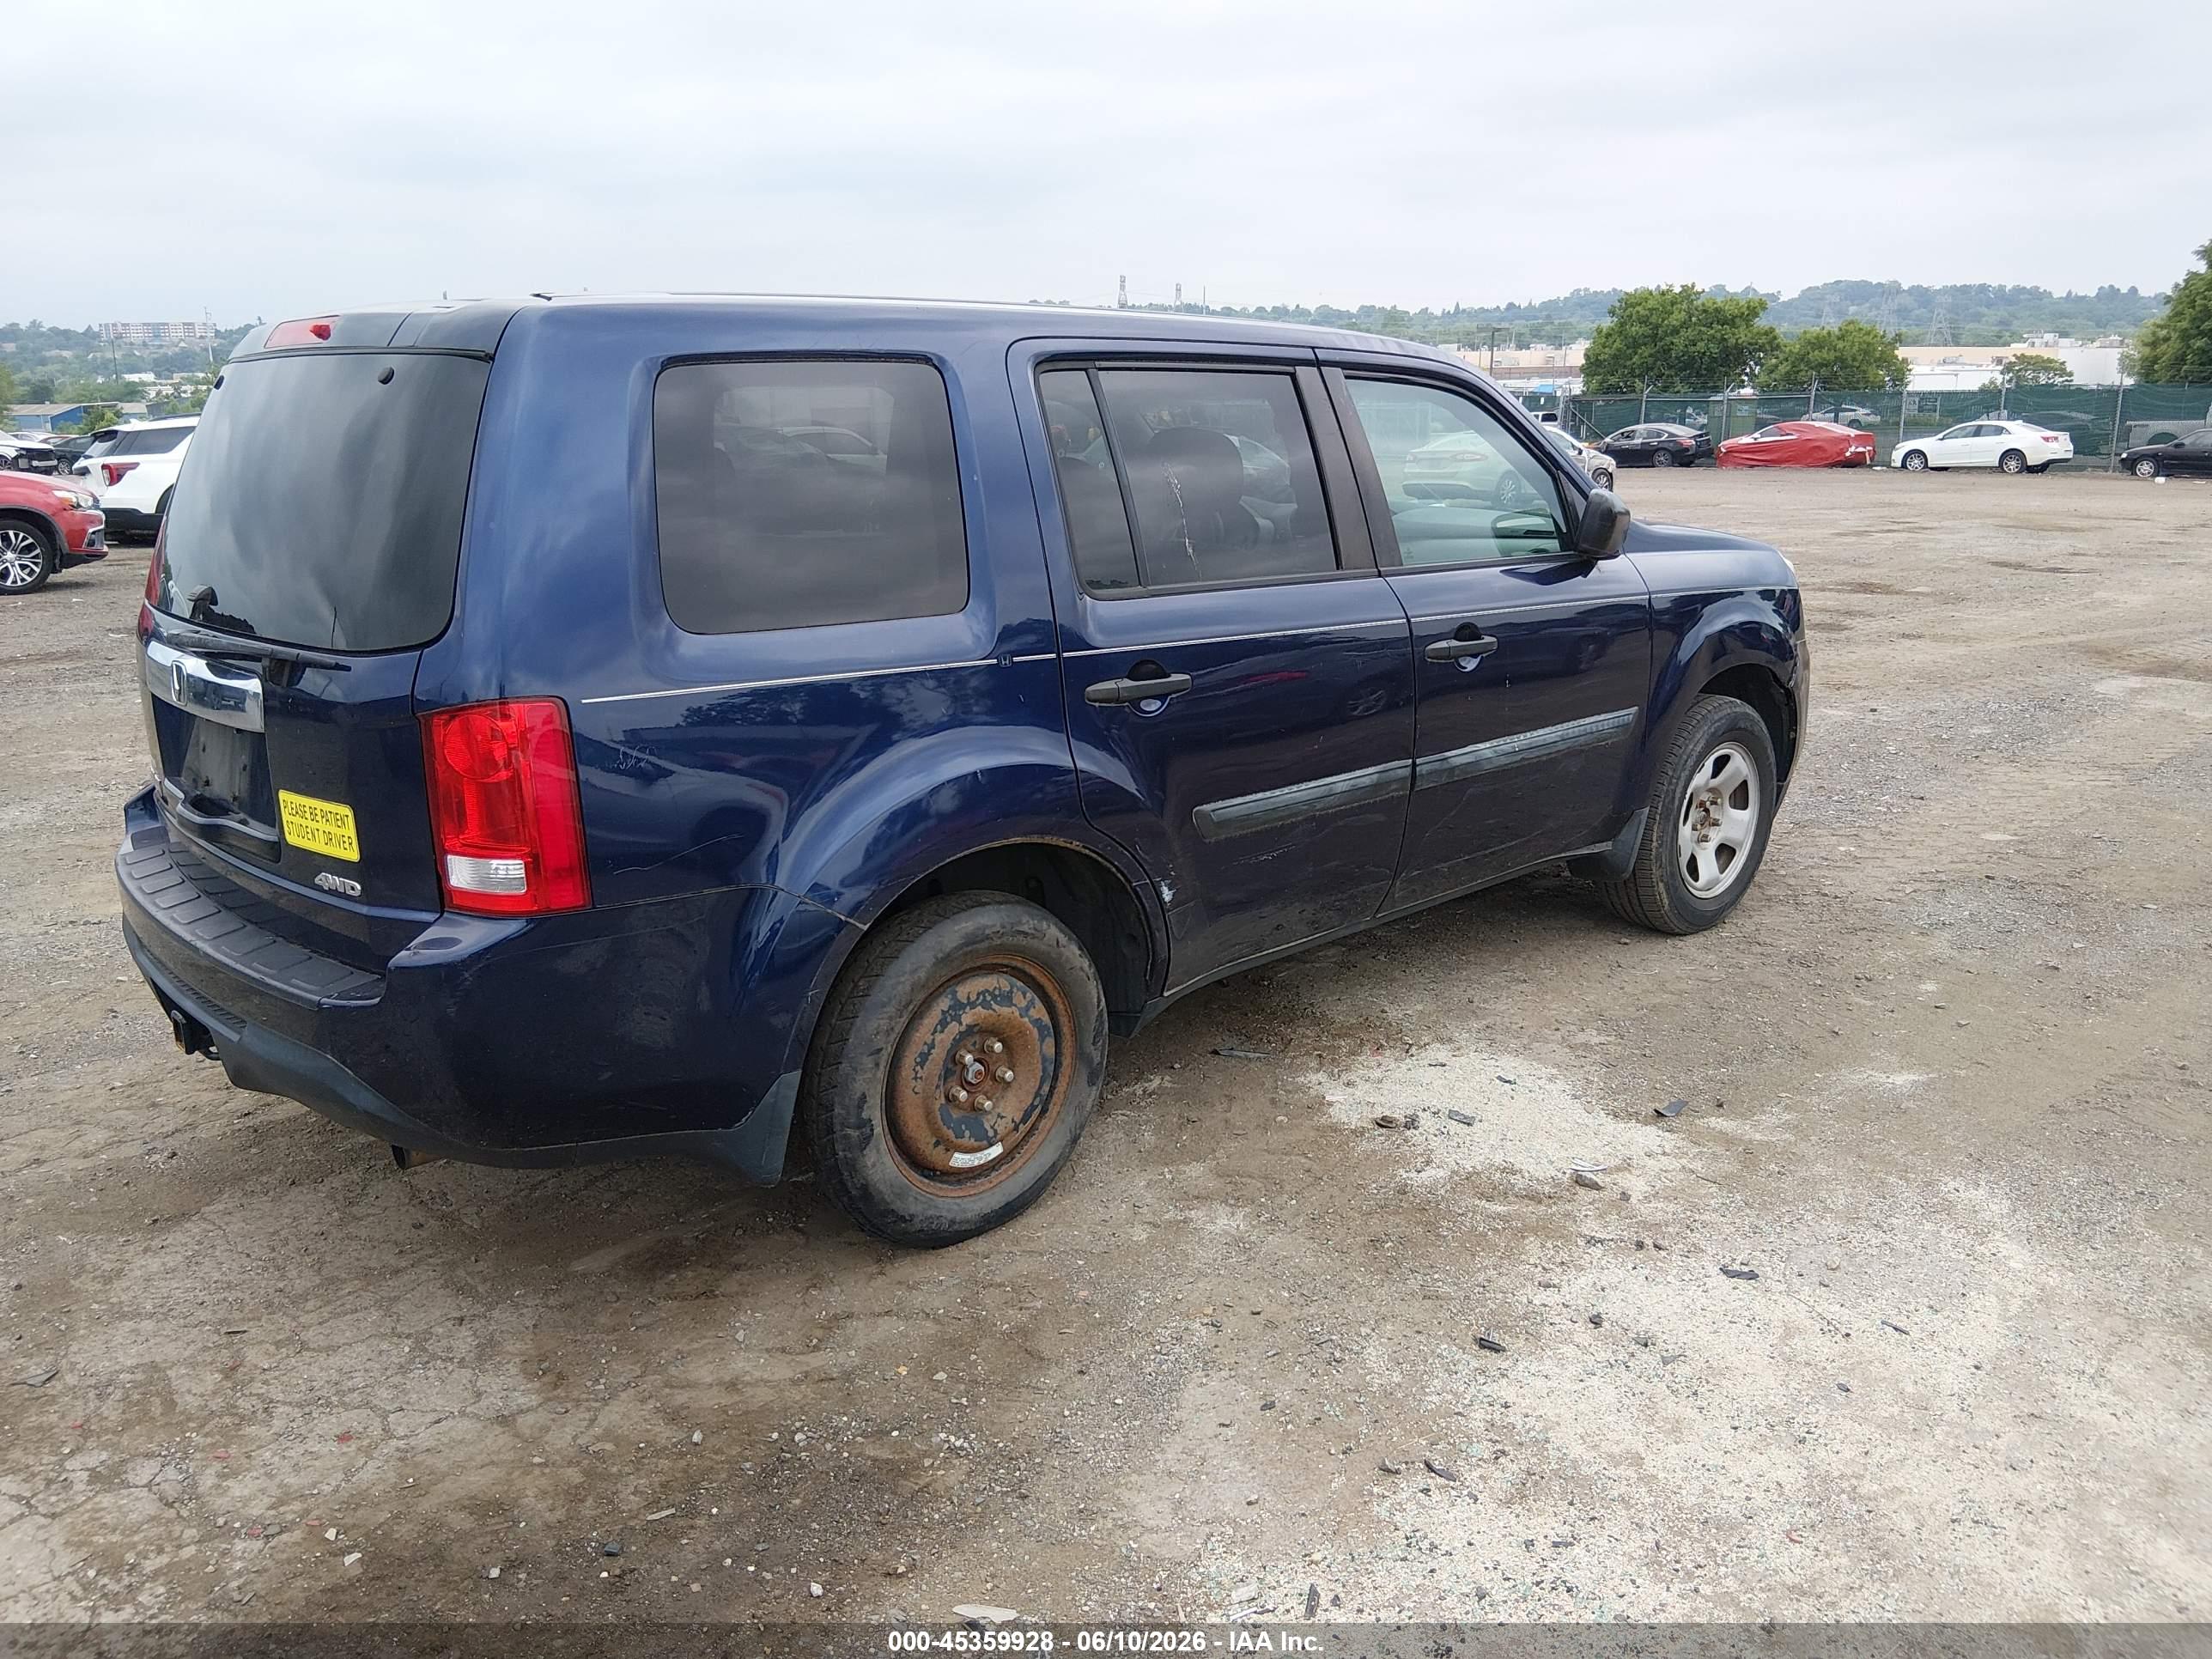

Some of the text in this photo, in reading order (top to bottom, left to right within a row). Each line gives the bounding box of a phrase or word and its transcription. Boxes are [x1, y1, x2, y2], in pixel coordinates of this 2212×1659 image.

[283, 799, 349, 830] PLEASE BE PATIENT
[286, 820, 355, 853] STUDENT DRIVER
[314, 872, 362, 896] 4WD
